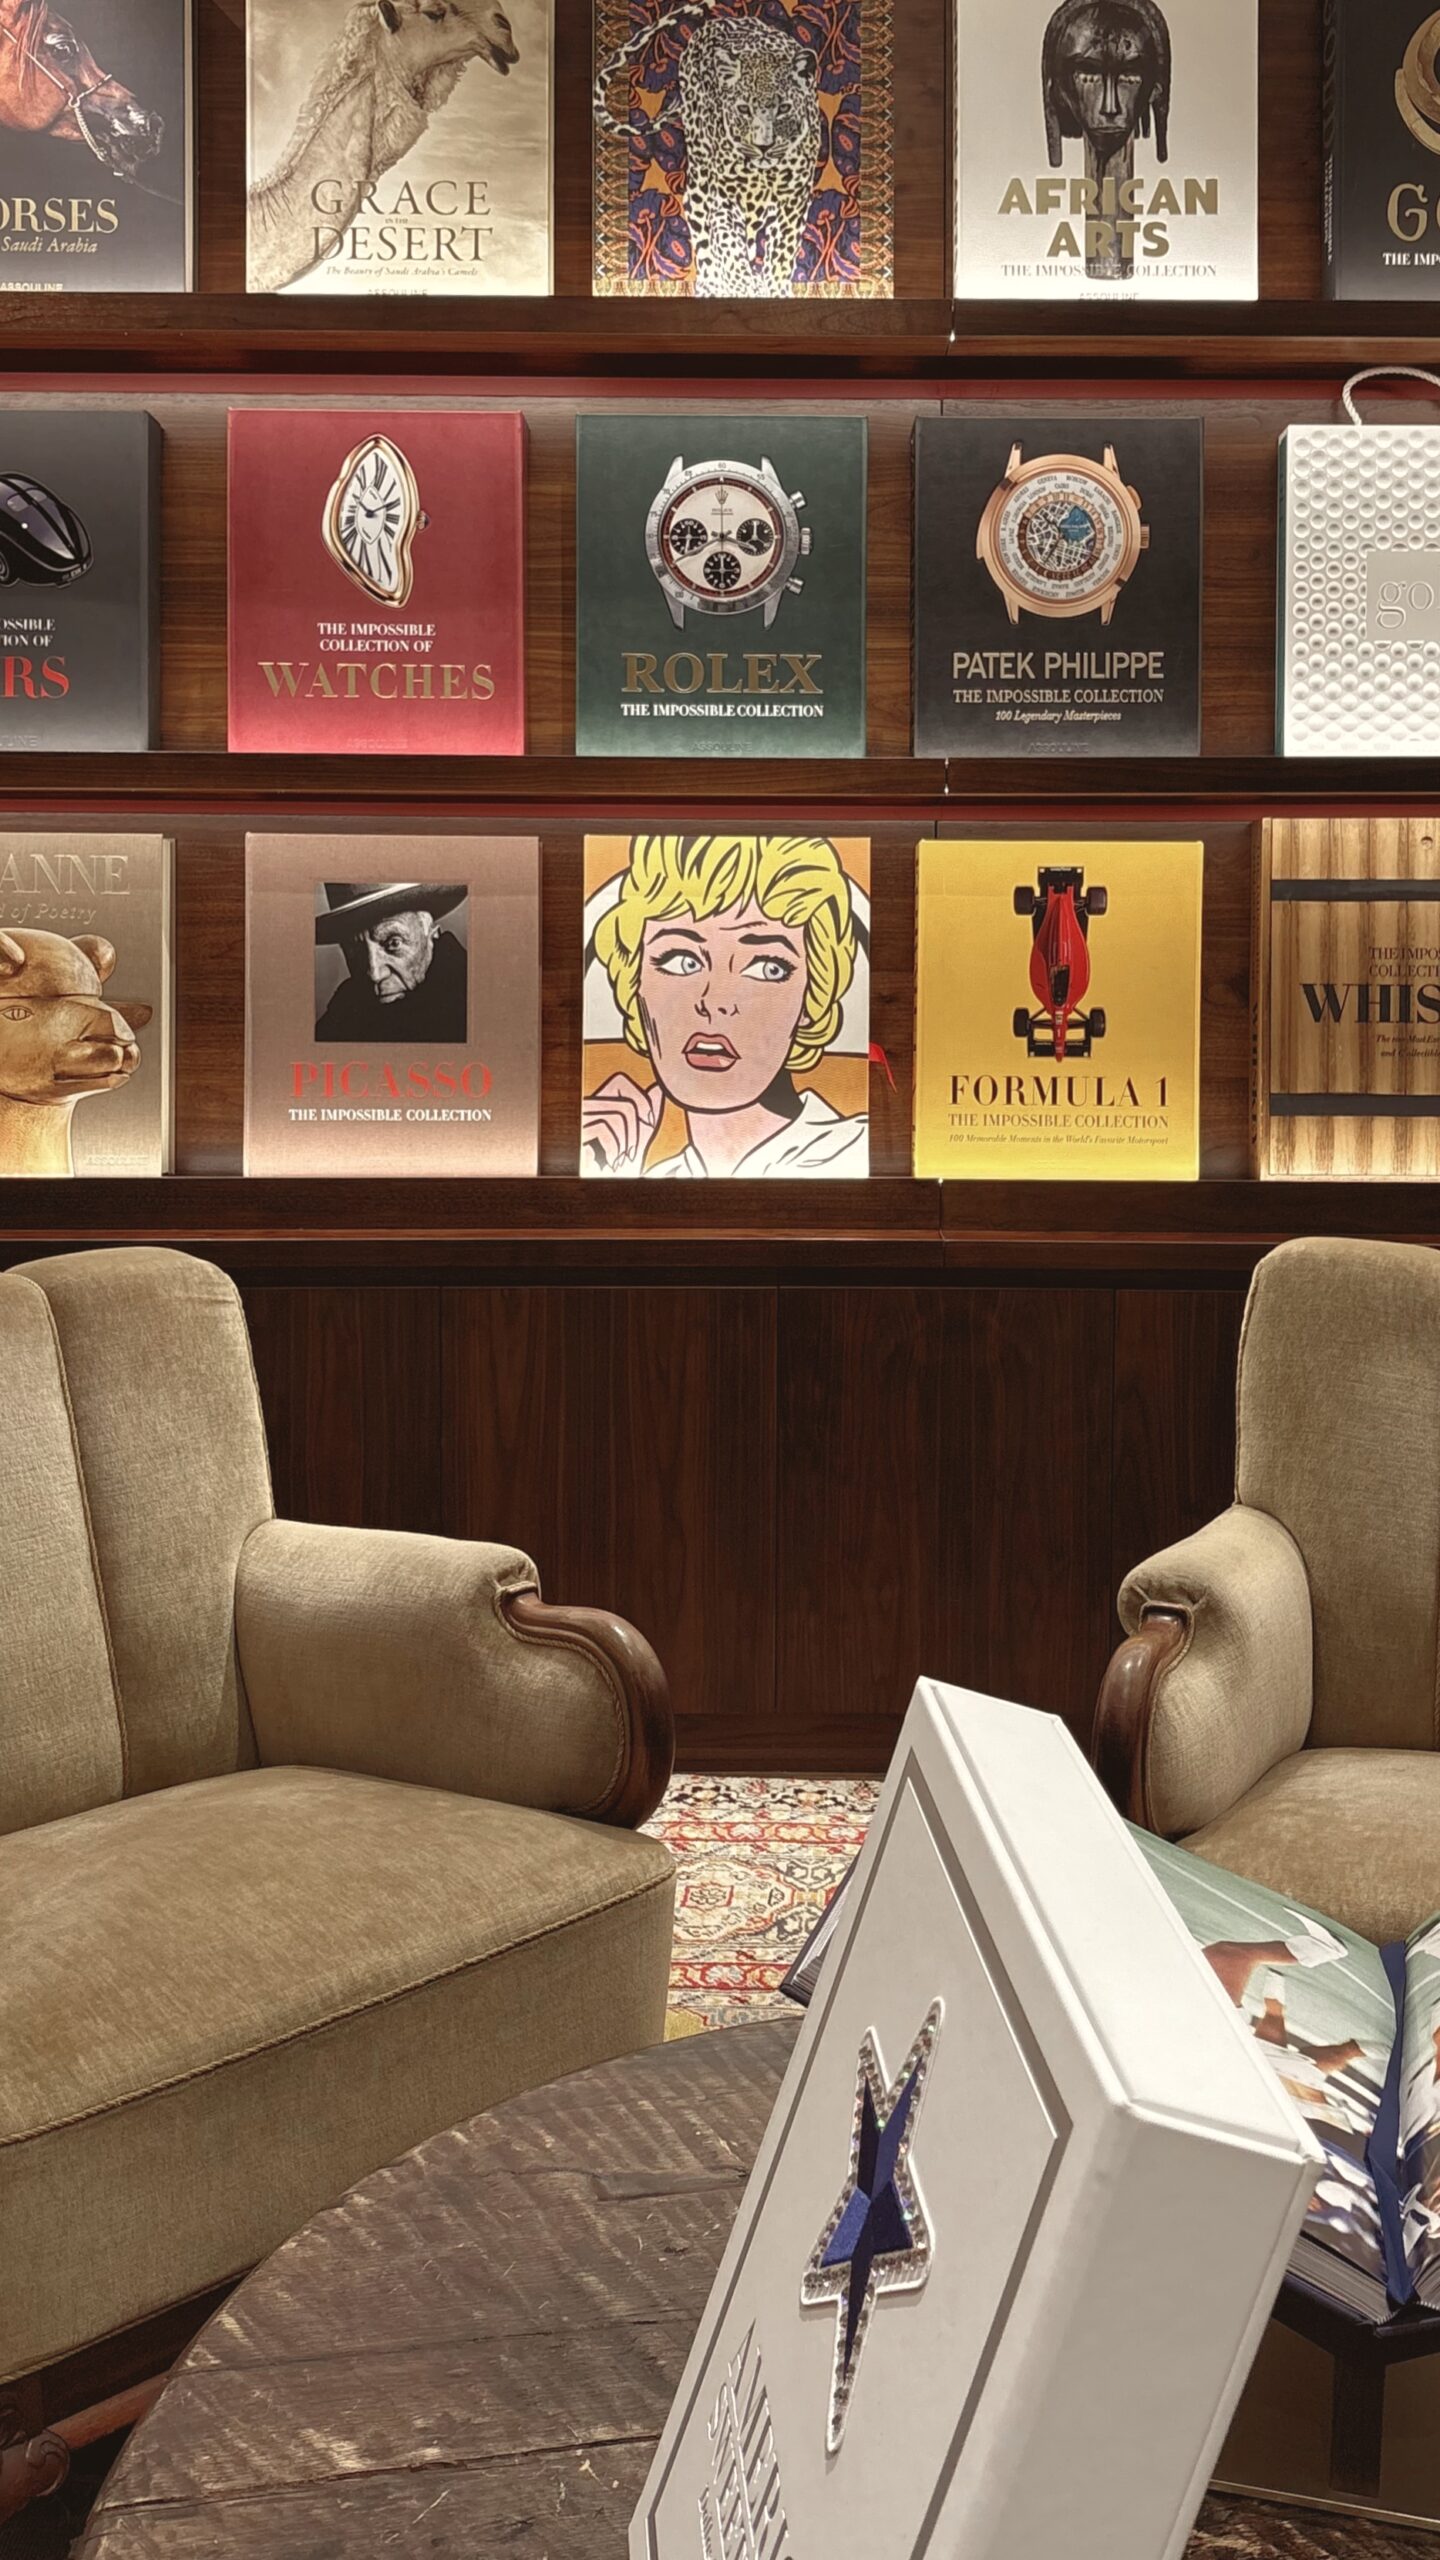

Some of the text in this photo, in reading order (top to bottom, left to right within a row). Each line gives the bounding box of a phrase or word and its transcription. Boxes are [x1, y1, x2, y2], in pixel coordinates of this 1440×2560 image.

[310, 178, 492, 216] GRACE
[997, 176, 1219, 216] AFRICAN
[2, 236, 99, 254] Saudi Arabia
[310, 225, 494, 262] DESERT
[1045, 220, 1171, 258] ARTS
[1383, 252, 1411, 266] THE
[1000, 264, 1218, 277] THE IMPOSSIBLE COLLECTION
[316, 622, 437, 637] THE IMPOSSIBLE
[32, 634, 54, 648] OF
[319, 638, 434, 653] COLLECTION OF
[620, 652, 825, 695] ROLEX
[952, 651, 1165, 680] PATEK PHILIPPE
[257, 661, 496, 701] WATCHES
[952, 689, 1165, 704] THE IMPOSSIBLE COLLECTION
[620, 703, 825, 718] THE IMPOSSIBLE COLLECTION
[995, 709, 1122, 725] 100 Legendary Masterpieces
[10, 903, 32, 924] of
[34, 903, 97, 925] Poetry
[1368, 946, 1399, 960] THE
[288, 1061, 494, 1099] PICASSO
[948, 1074, 1170, 1108] FORMULA 1
[288, 1108, 493, 1122] THE IMPOSSIBLE COLLECTION
[948, 1112, 1170, 1129] THE IMPOSSIBLE COLLECTION
[949, 1133, 965, 1143] 100
[966, 1133, 1007, 1143] Memorable
[1008, 1134, 1042, 1144] Moments
